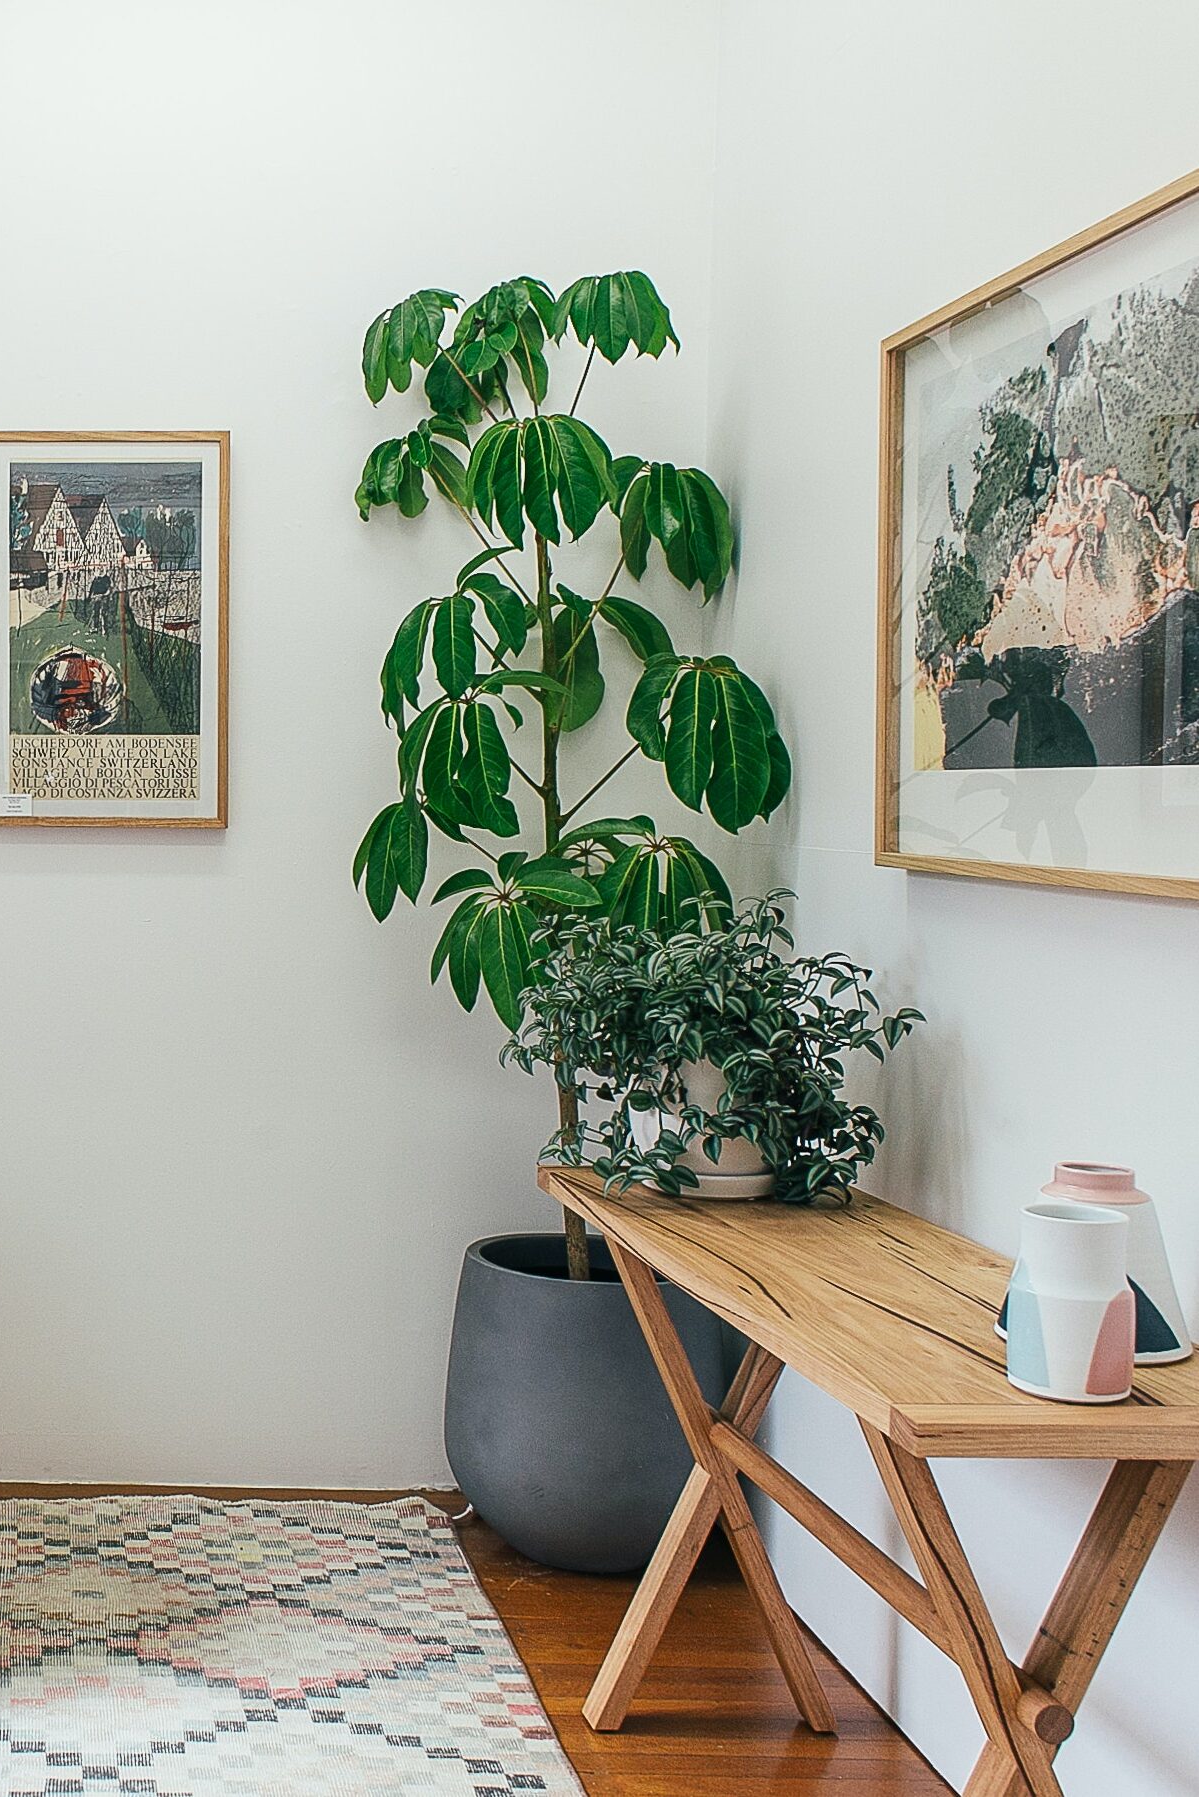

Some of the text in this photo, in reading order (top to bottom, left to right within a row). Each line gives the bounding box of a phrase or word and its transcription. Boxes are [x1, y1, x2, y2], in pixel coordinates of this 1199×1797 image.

[12, 738, 197, 748] FISCHERDORF AM BODENSEE
[12, 748, 197, 758] SCHWEIZ VILLAGE ON LAKE
[12, 758, 198, 768] CONSTANCE SWITZERLAND
[12, 768, 197, 778] VILLAGE AU BODAN SUISSE
[12, 778, 197, 788] VILLAGGIO DI PESCATORI SUL
[50, 788, 63, 799] DI
[67, 788, 132, 799] COSTANZA
[136, 788, 197, 799] SVIZZERA
